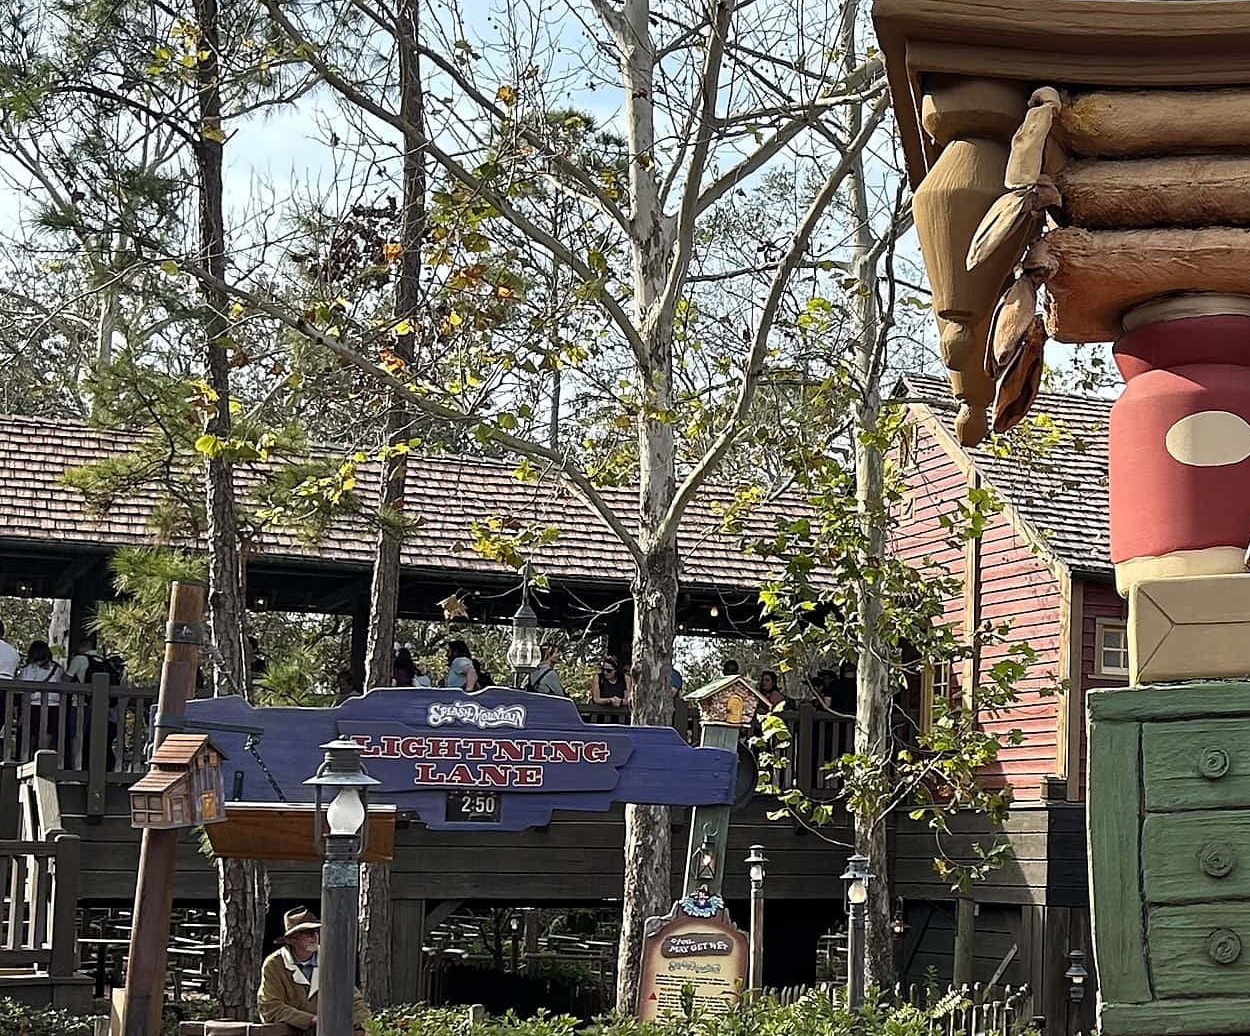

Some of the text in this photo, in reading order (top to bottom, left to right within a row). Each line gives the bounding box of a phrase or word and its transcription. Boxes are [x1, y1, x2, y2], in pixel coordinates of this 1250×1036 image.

[429, 702, 525, 728] SPLASH MOUNTAIN
[350, 735, 610, 763] LIGHTNING
[415, 763, 543, 787] LANE
[461, 795, 496, 813] 2:50
